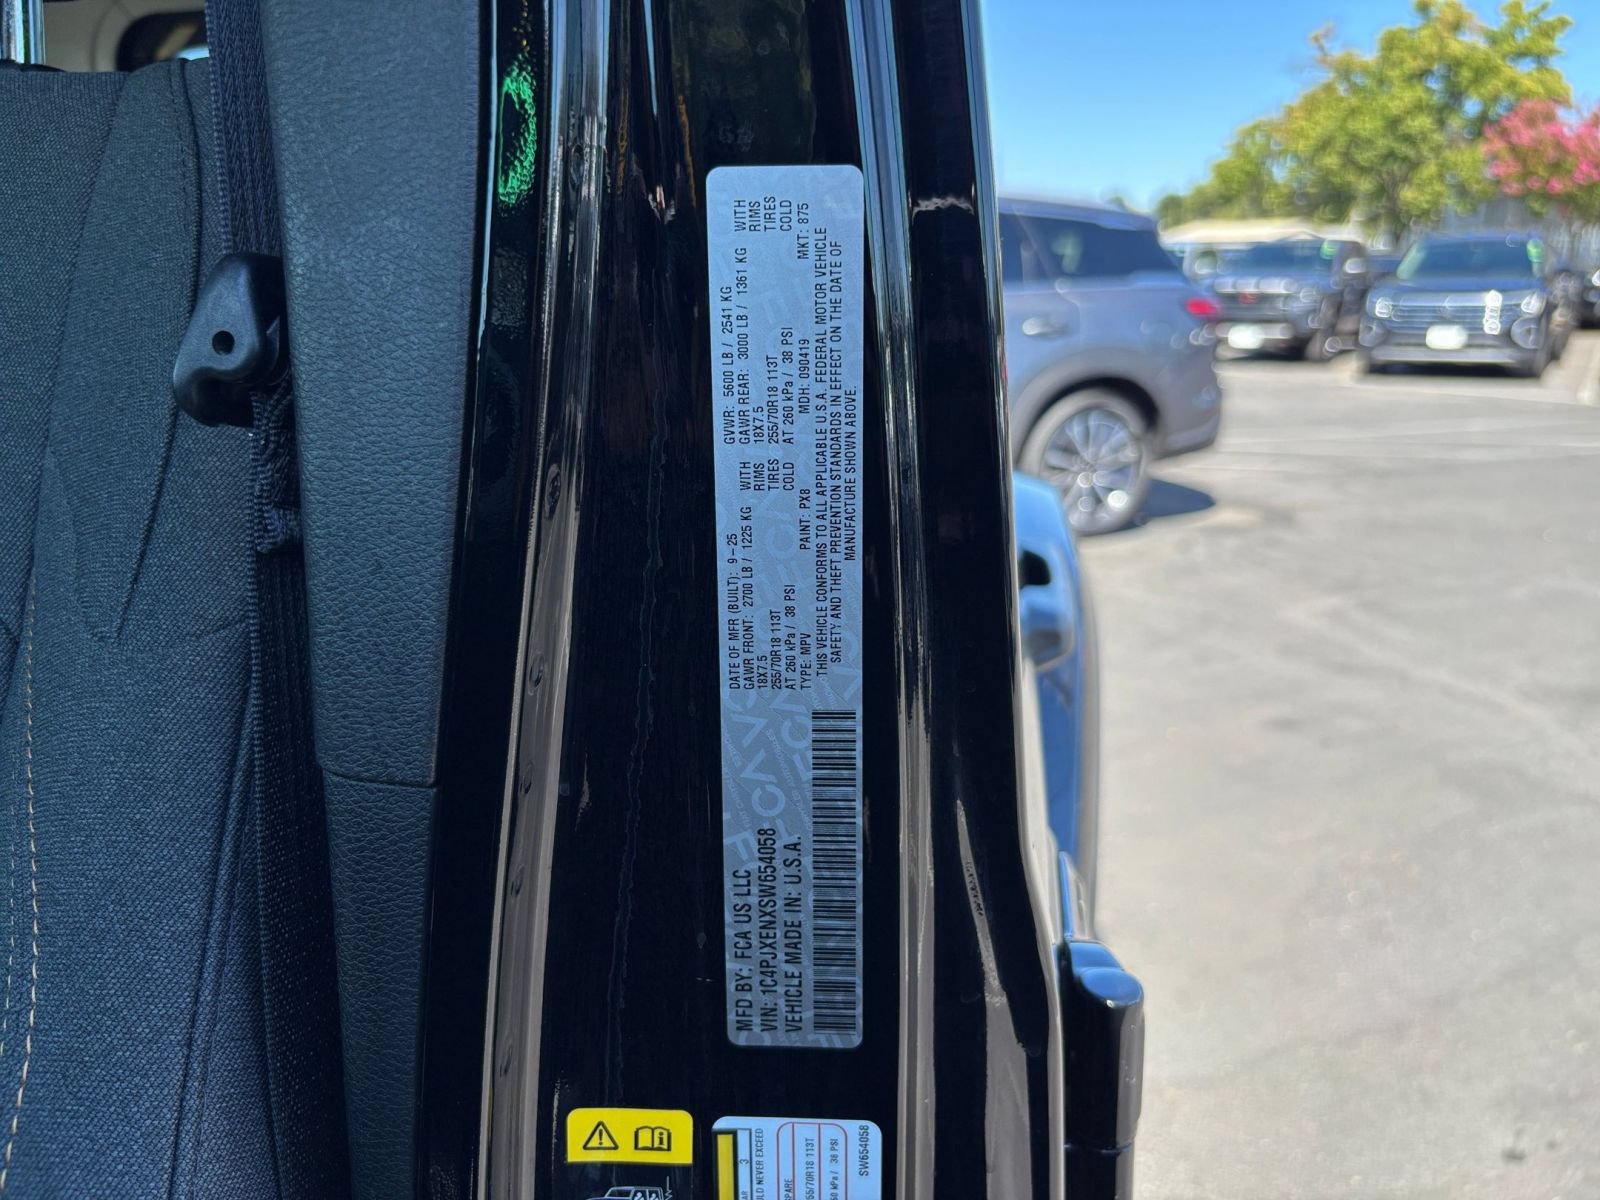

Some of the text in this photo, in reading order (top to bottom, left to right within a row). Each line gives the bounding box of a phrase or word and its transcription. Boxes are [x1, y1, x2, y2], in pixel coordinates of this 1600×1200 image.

[734, 200, 746, 232] WITH
[748, 201, 761, 231] RIMS
[764, 196, 776, 232] TIRES
[780, 200, 792, 231] COLD
[797, 203, 809, 259] MKT: 875
[735, 248, 747, 263] KG
[720, 287, 732, 302] KG
[736, 270, 747, 295] 1361
[721, 308, 733, 334] 2541
[736, 314, 748, 328] LB
[737, 333, 749, 360] 3000
[781, 327, 793, 345] PSI
[722, 352, 734, 365] LB
[782, 351, 793, 364] 38
[723, 371, 734, 397] 5600
[738, 369, 750, 405] REAR:
[781, 381, 794, 401] kPa
[798, 339, 810, 414] MDH: 090419
[766, 355, 779, 444] 255/70R18 113T
[723, 406, 735, 444] GVWR:
[738, 409, 750, 444] GAWR
[752, 406, 765, 444] 18X7.5
[782, 406, 794, 425] 260
[782, 430, 794, 444] AT
[814, 228, 828, 677] THIS VEHICLE CONFORMS TO ALL APPLICABLE U.S.A. FEDERAL MOTOR VEHICLE
[830, 241, 842, 663] SAFETY AND THEFT PREVENTION STANDARDS IN EFFECT ON THE DATE OF
[739, 462, 752, 491] WITH
[753, 463, 765, 491] RIMS
[767, 459, 780, 491] TIRES
[782, 462, 794, 491] COLD
[844, 386, 856, 560] MANUFACTURE SHOWN ABOVE.
[740, 507, 752, 521] KG
[799, 489, 811, 550] PAINT: PX8
[741, 525, 752, 549] 1225
[741, 567, 753, 578] LB
[727, 573, 741, 614] (BUILT):
[742, 583, 753, 607] 2700
[784, 585, 795, 601] PSI
[785, 606, 795, 617] 38
[728, 619, 739, 640] MFR
[742, 616, 754, 653] FRONT:
[783, 633, 796, 651] kPa
[729, 645, 740, 659] OF
[770, 609, 782, 690] 255/70R18 113T
[785, 655, 796, 673] 260
[800, 633, 812, 690] TYPE: MPV
[729, 663, 740, 689] DATE
[743, 658, 755, 689] GAWR
[757, 655, 768, 689] 18X7.5
[785, 677, 796, 690] AT
[783, 837, 802, 884] U.S.A.
[784, 892, 802, 913] IN:
[757, 828, 778, 1032] VIN: 1C4PJXENXSW654058
[784, 920, 802, 964] MADE
[732, 870, 753, 1031] MFD BY: FCA US LLC
[784, 971, 803, 1032] VEHICLE
[806, 1161, 814, 1200] 55/70R18
